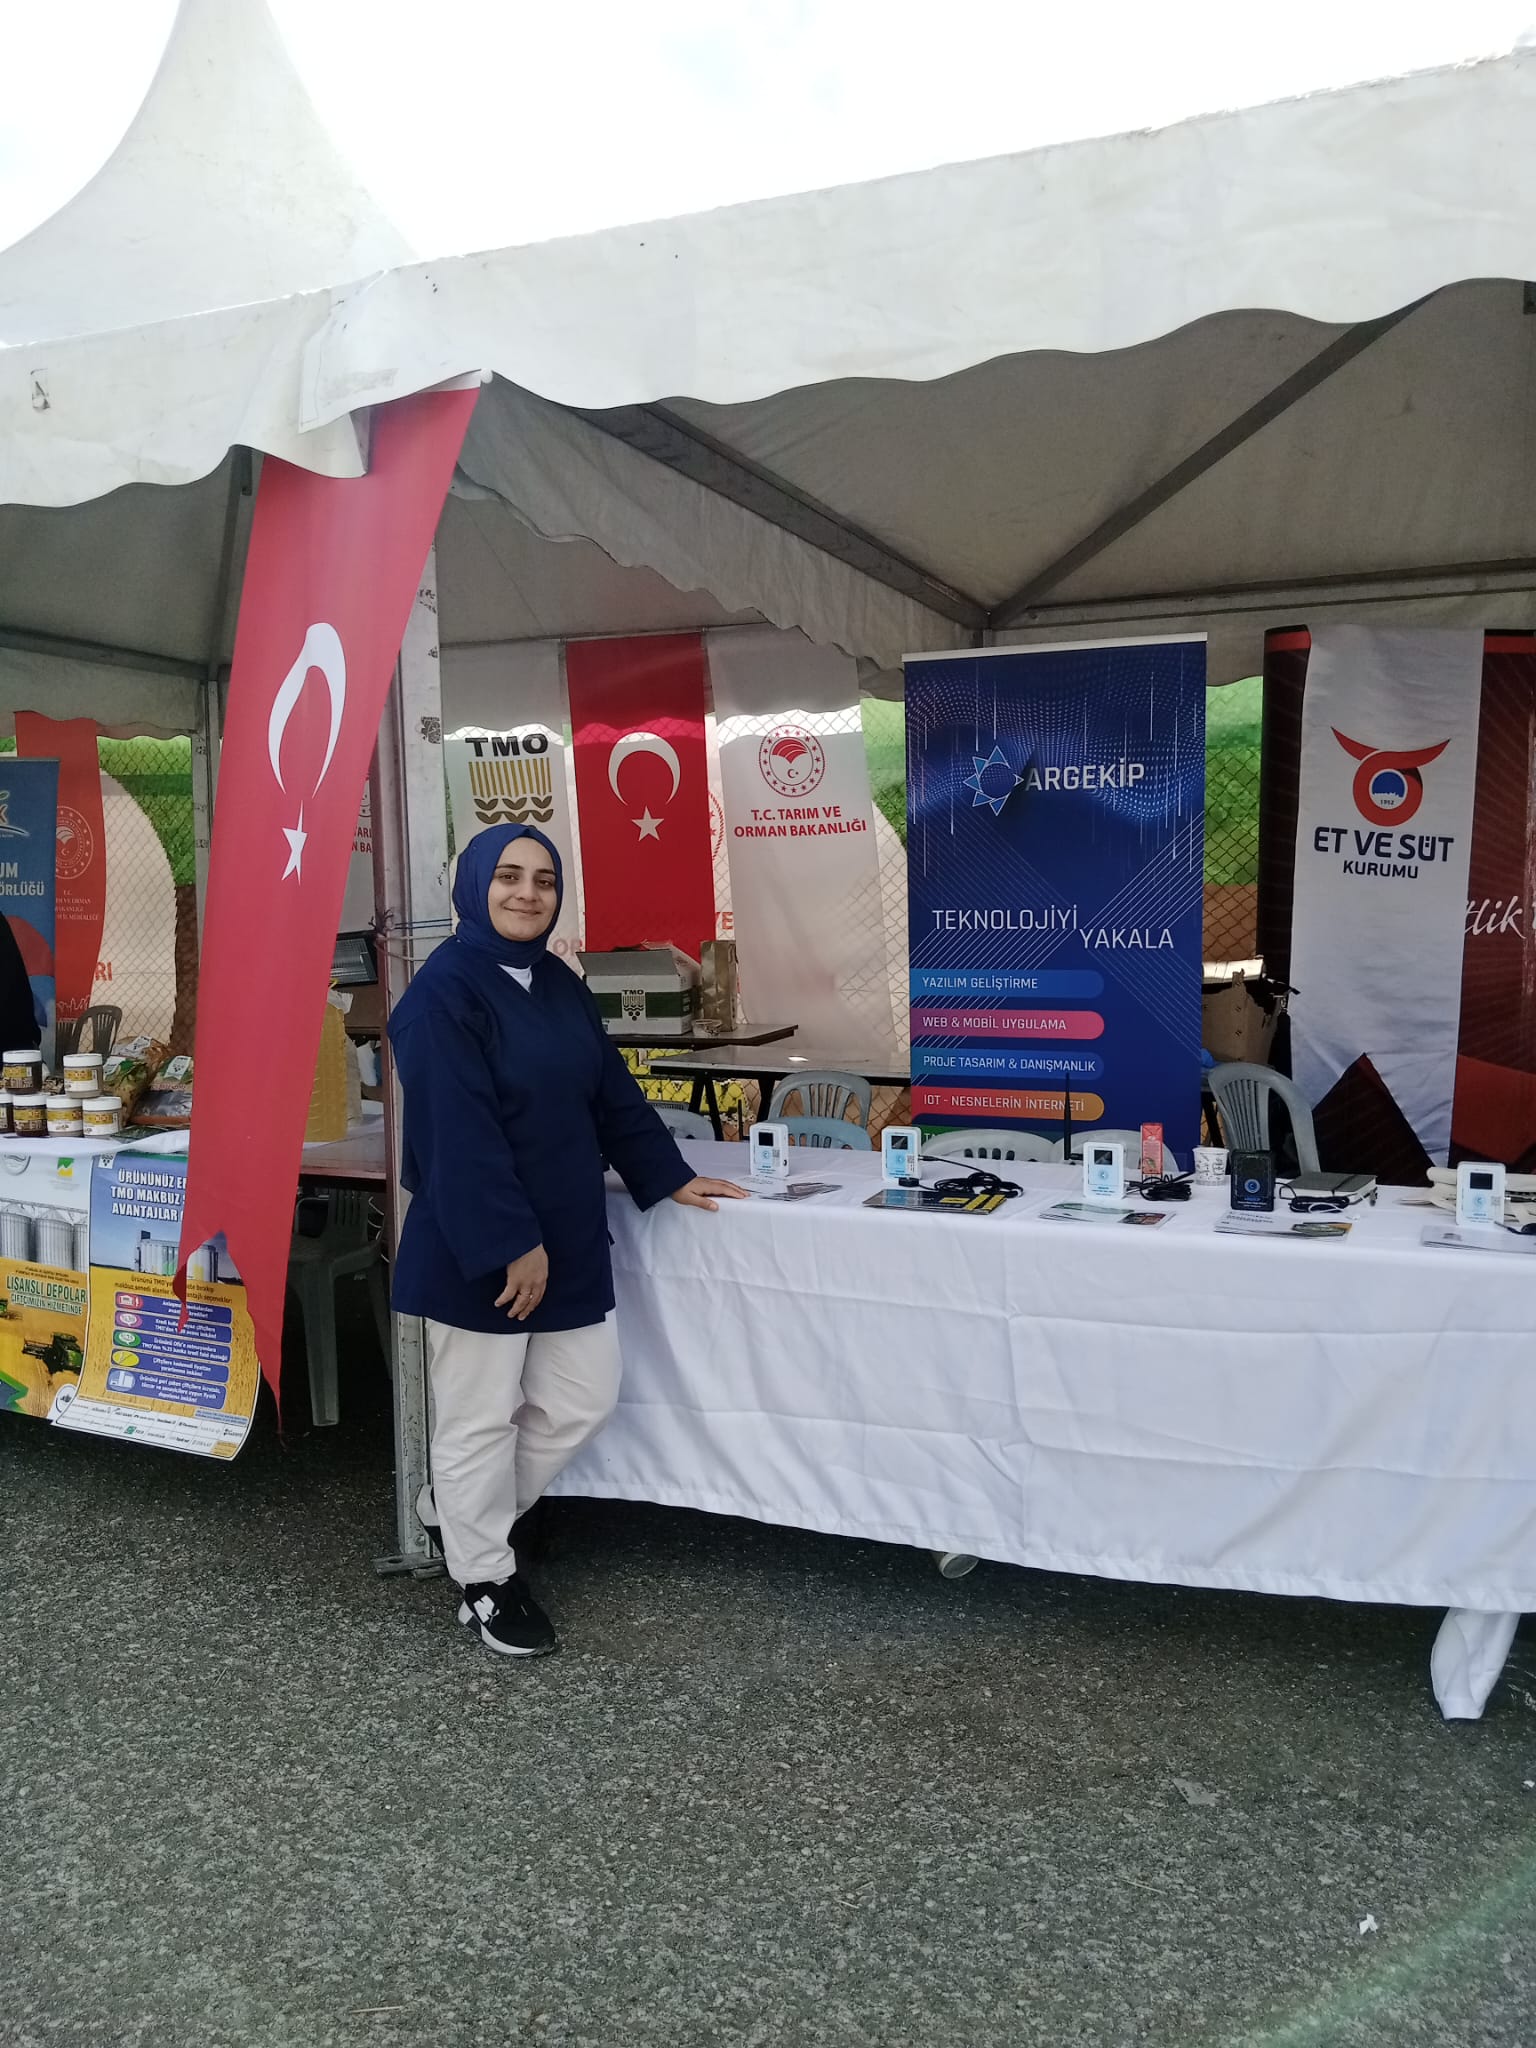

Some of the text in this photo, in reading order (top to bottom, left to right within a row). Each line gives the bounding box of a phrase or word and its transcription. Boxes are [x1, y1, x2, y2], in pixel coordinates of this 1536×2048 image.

[465, 733, 549, 757] TMO
[1025, 758, 1145, 791] ARGEKİP
[751, 805, 842, 821] T.C. TARIM VE
[734, 818, 867, 838] ORMAN BAKANLIĞI
[1313, 826, 1454, 862] ET VE SÜT
[1342, 860, 1419, 879] KURUMU
[932, 904, 1078, 930] TEKNOLOJİYİ
[1079, 928, 1174, 949] YAKALA
[922, 975, 1038, 990] YAZILIM GELİŞTİRME
[922, 1016, 1067, 1030] WEB & MOBİL UYGULAMA
[923, 1055, 1096, 1073] PROJE TASARIM & DANIŞMANLIK
[924, 1094, 941, 1105] IOT
[951, 1095, 1022, 1109] NESNELERİN
[118, 1168, 175, 1188] ÜRÜNÜNÜZ
[111, 1186, 180, 1205] TMO MAKBUZ
[112, 1203, 178, 1222] AVANTAJLAR
